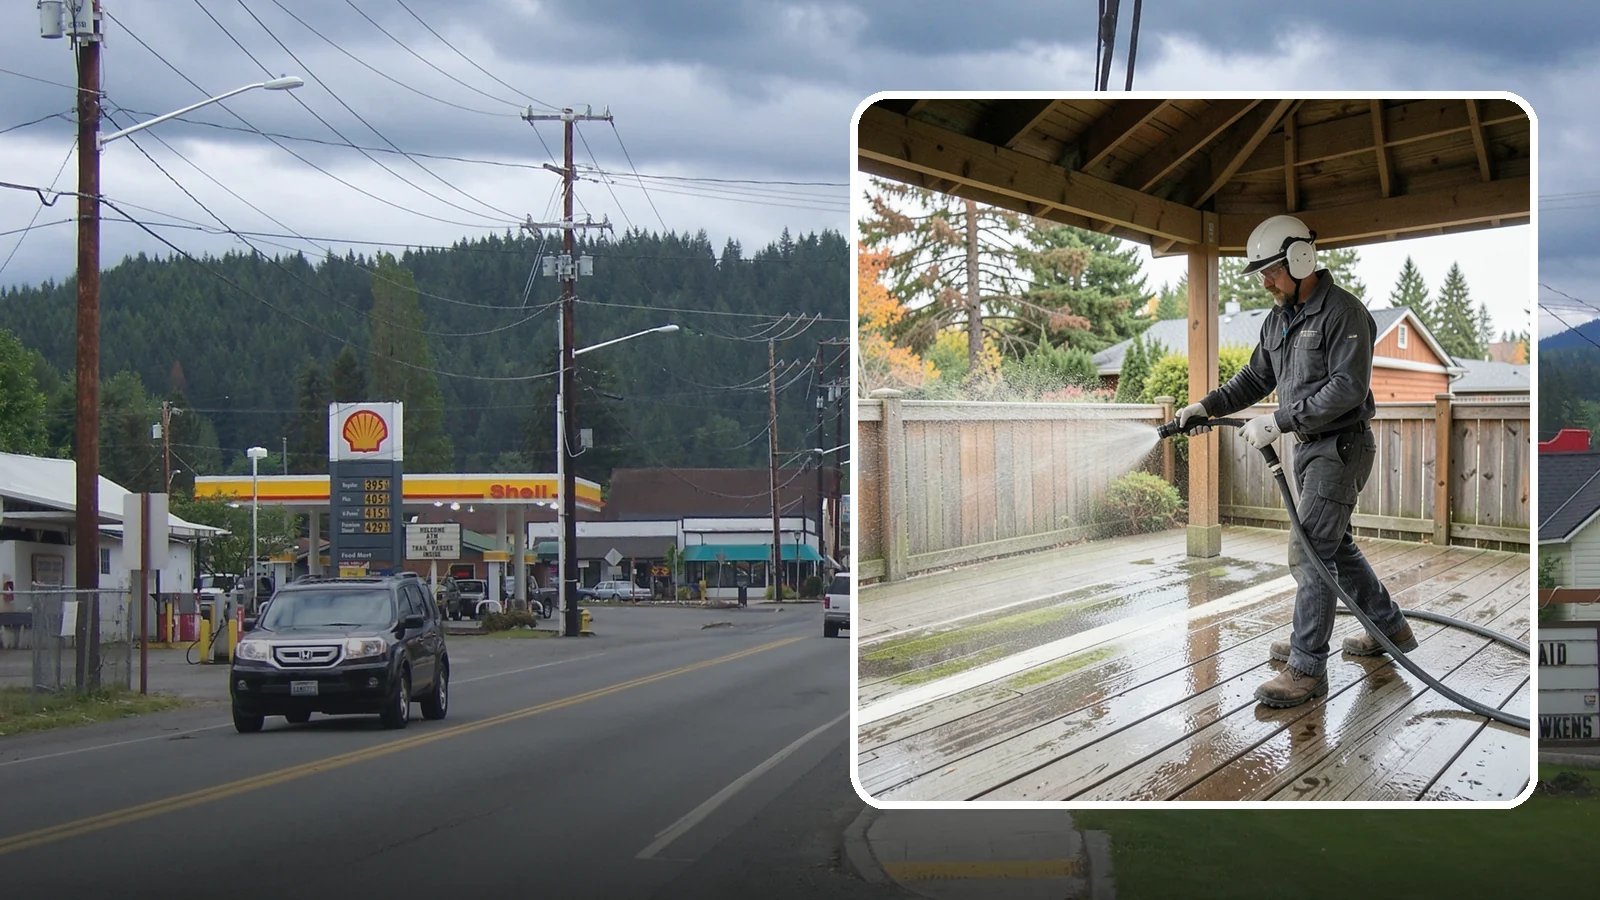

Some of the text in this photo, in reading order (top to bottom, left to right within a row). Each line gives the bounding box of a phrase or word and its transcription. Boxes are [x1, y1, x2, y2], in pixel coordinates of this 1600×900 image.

[366, 480, 383, 490] 395
[490, 484, 547, 499] Shell
[365, 494, 383, 504] 405
[365, 508, 383, 518] 415
[365, 522, 383, 533] 429
[1538, 643, 1567, 665] AID
